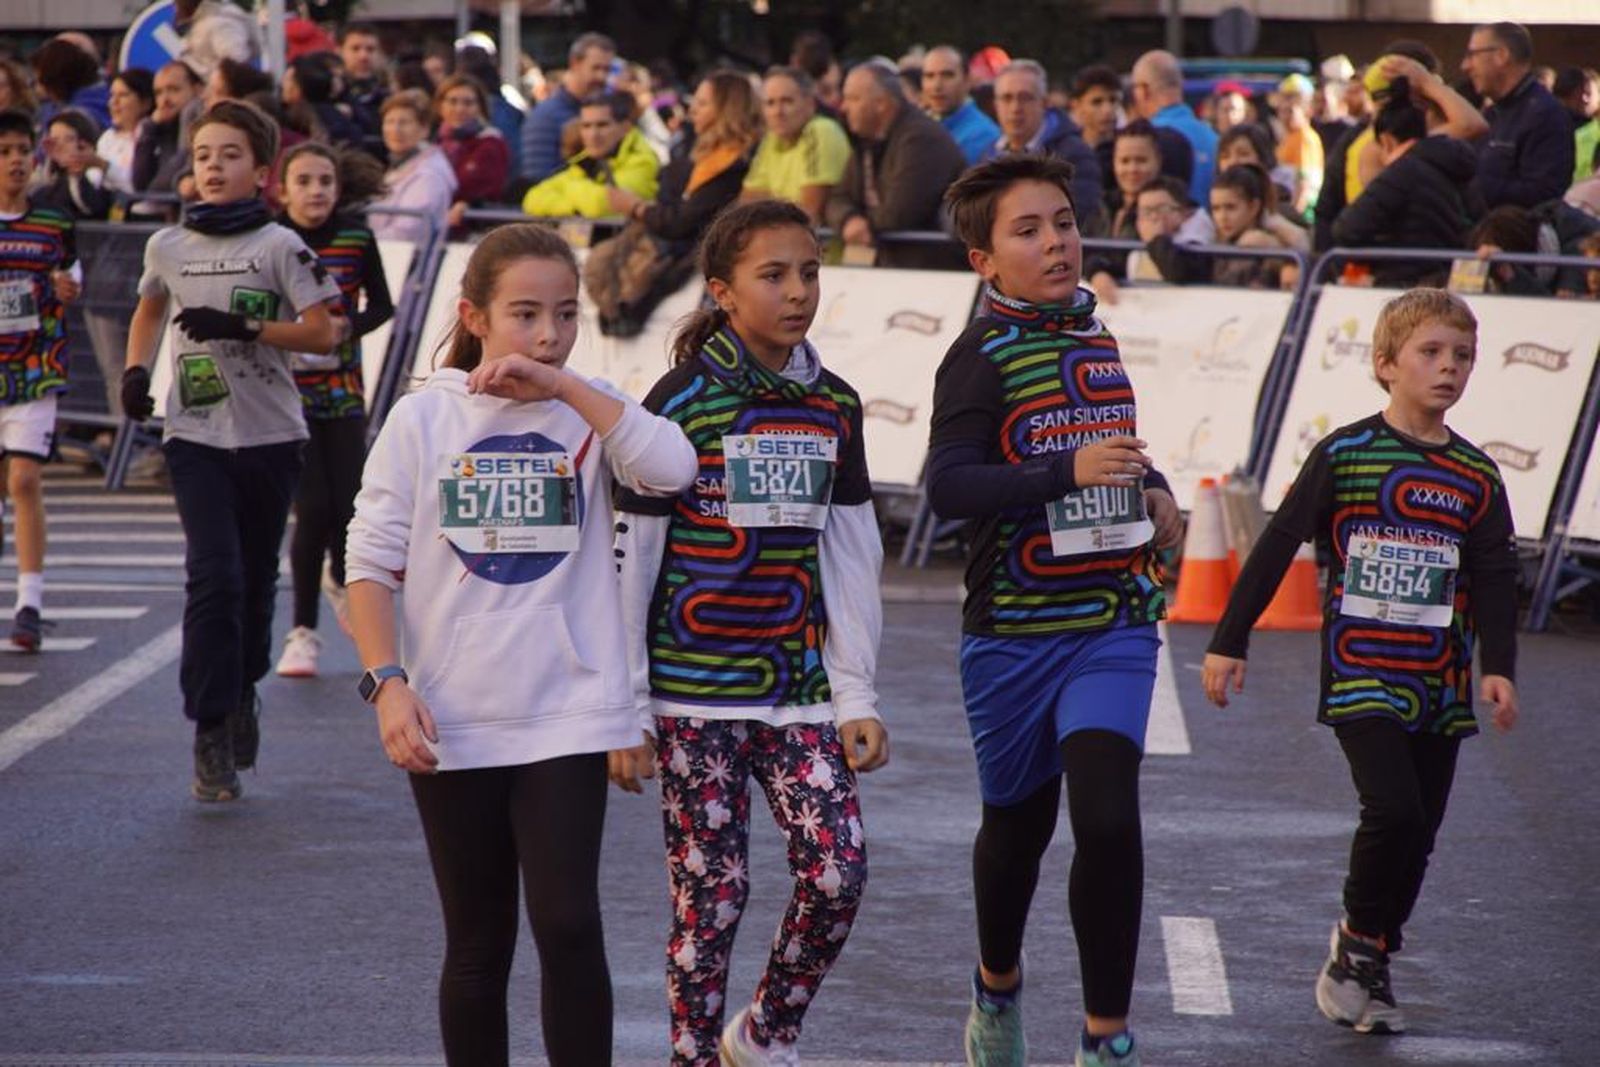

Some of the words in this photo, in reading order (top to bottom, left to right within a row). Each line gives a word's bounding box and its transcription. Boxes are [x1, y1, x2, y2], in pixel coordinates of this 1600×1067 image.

[1030, 409, 1070, 433] SAN
[758, 440, 826, 457] SETEL
[475, 458, 557, 474] SETEL
[748, 460, 812, 496] 5821
[458, 479, 545, 518] 5768
[1063, 485, 1129, 522] 5900
[1379, 544, 1450, 564] SETEL
[1359, 560, 1431, 599] 5854
